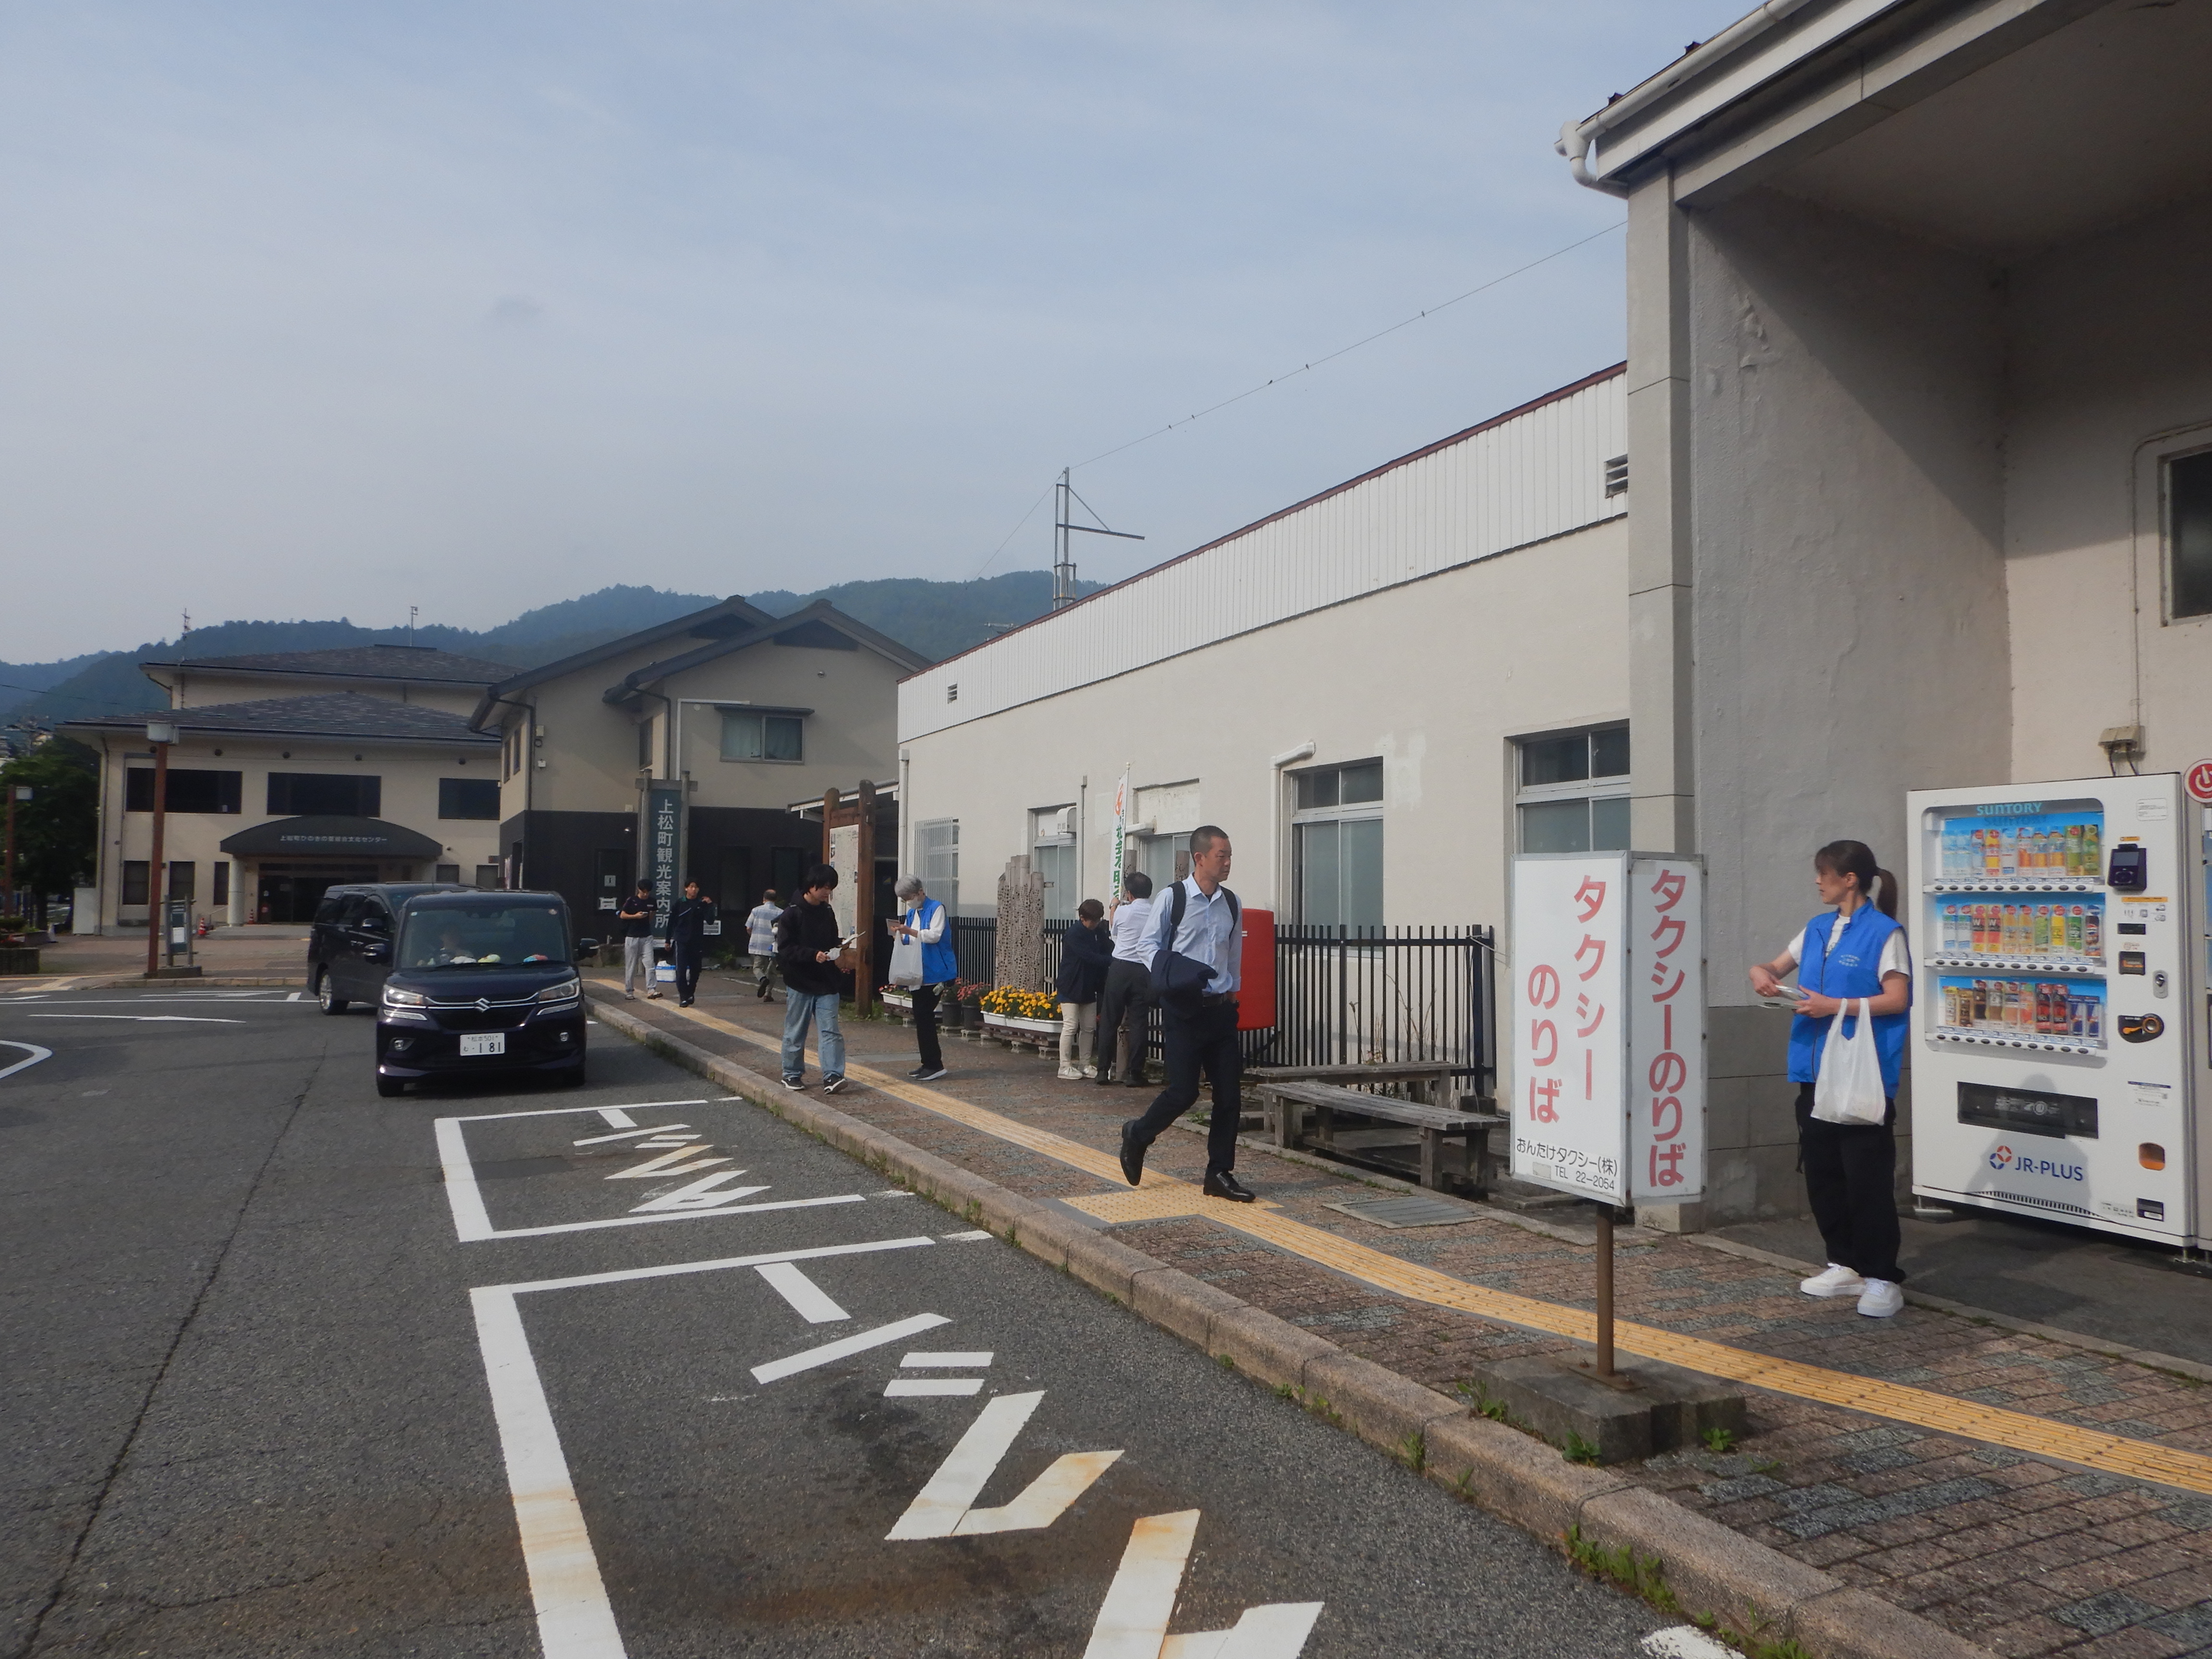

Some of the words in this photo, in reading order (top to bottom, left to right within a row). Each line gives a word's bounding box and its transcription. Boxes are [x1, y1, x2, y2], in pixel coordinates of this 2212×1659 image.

[655, 799, 674, 928] 上松町観光案内所
[1528, 964, 1563, 1123] のりば
[1574, 875, 1606, 1101] タクシー
[1649, 869, 1687, 1188] タクシーのりば
[1516, 1137, 1618, 1177] おんたけタクシー(株)
[1555, 1165, 1568, 1179] TEL
[1575, 1170, 1615, 1191] 22-2054
[2015, 1156, 2084, 1181] JR-PLUS
